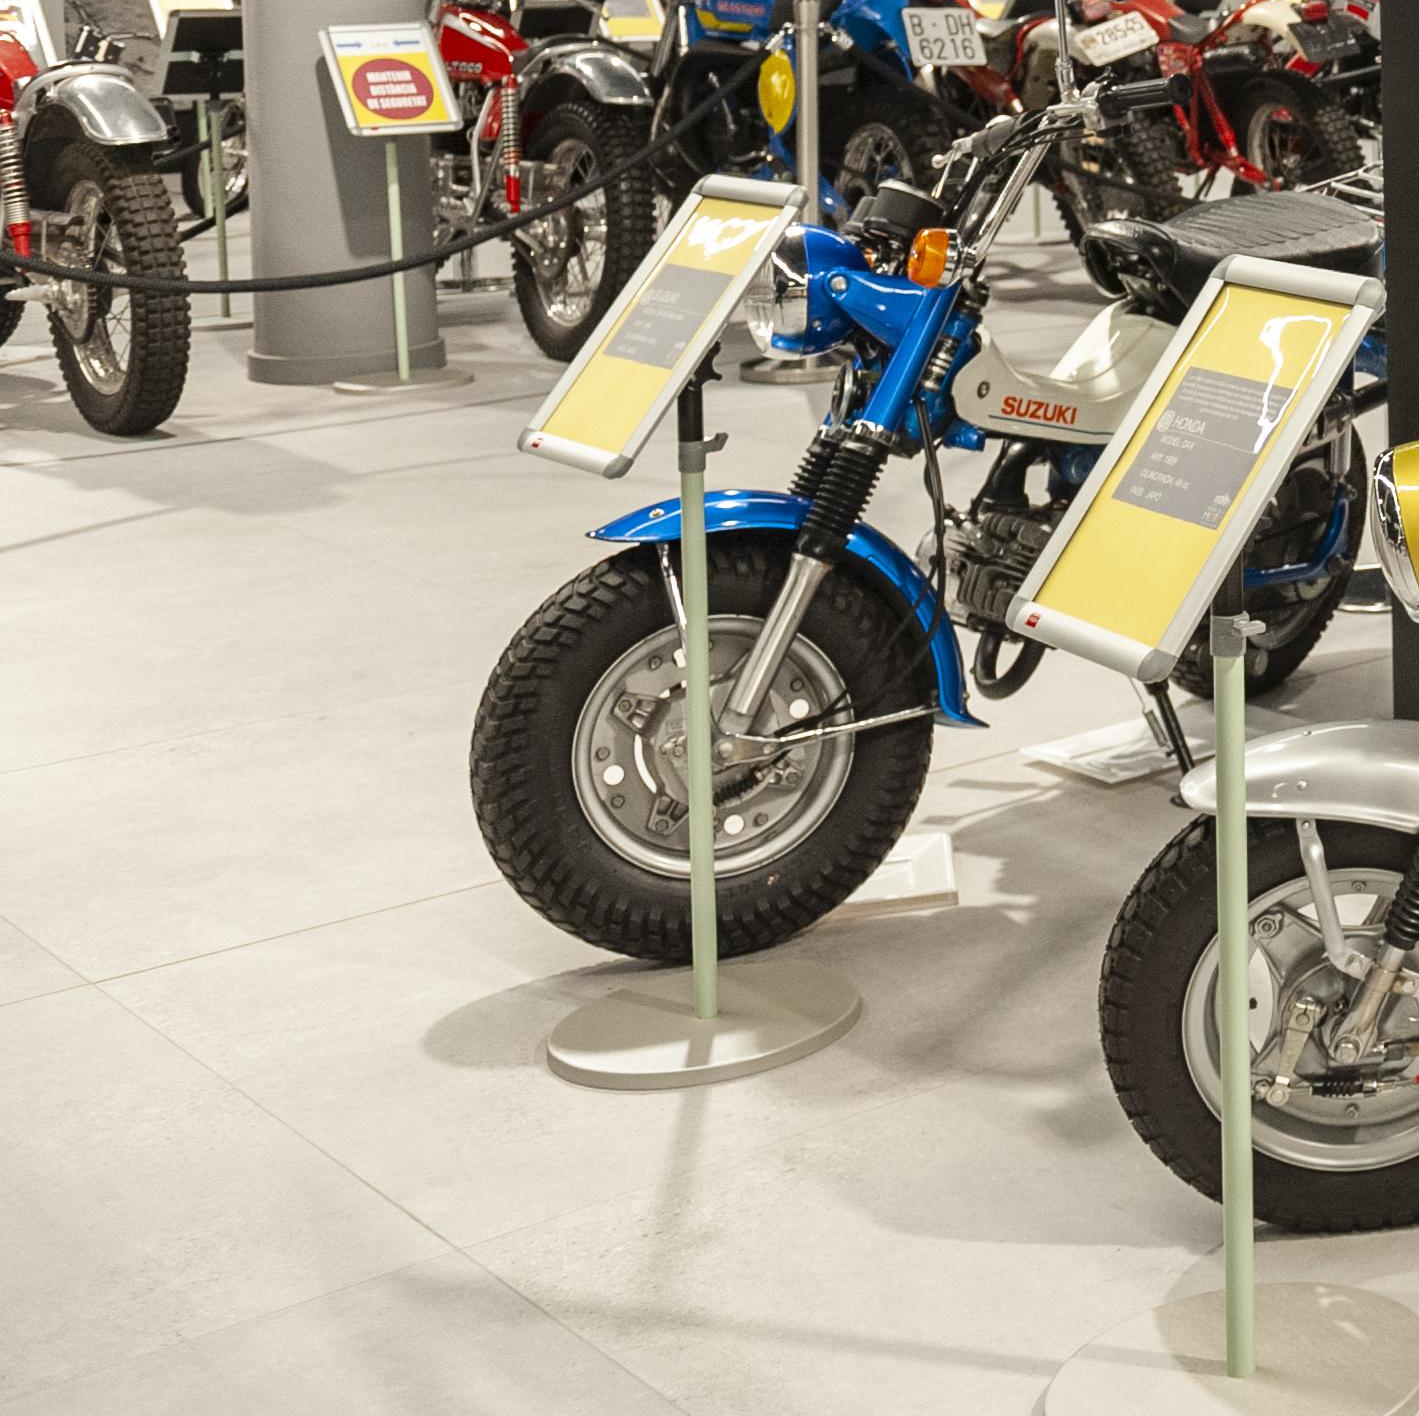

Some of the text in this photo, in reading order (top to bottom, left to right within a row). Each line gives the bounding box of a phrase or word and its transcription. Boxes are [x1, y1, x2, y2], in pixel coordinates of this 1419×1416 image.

[909, 13, 974, 36] B DH
[919, 38, 975, 60] 6216
[366, 98, 380, 110] DE
[1001, 396, 1077, 424] SUZUKI
[1172, 415, 1206, 434] HONDA
